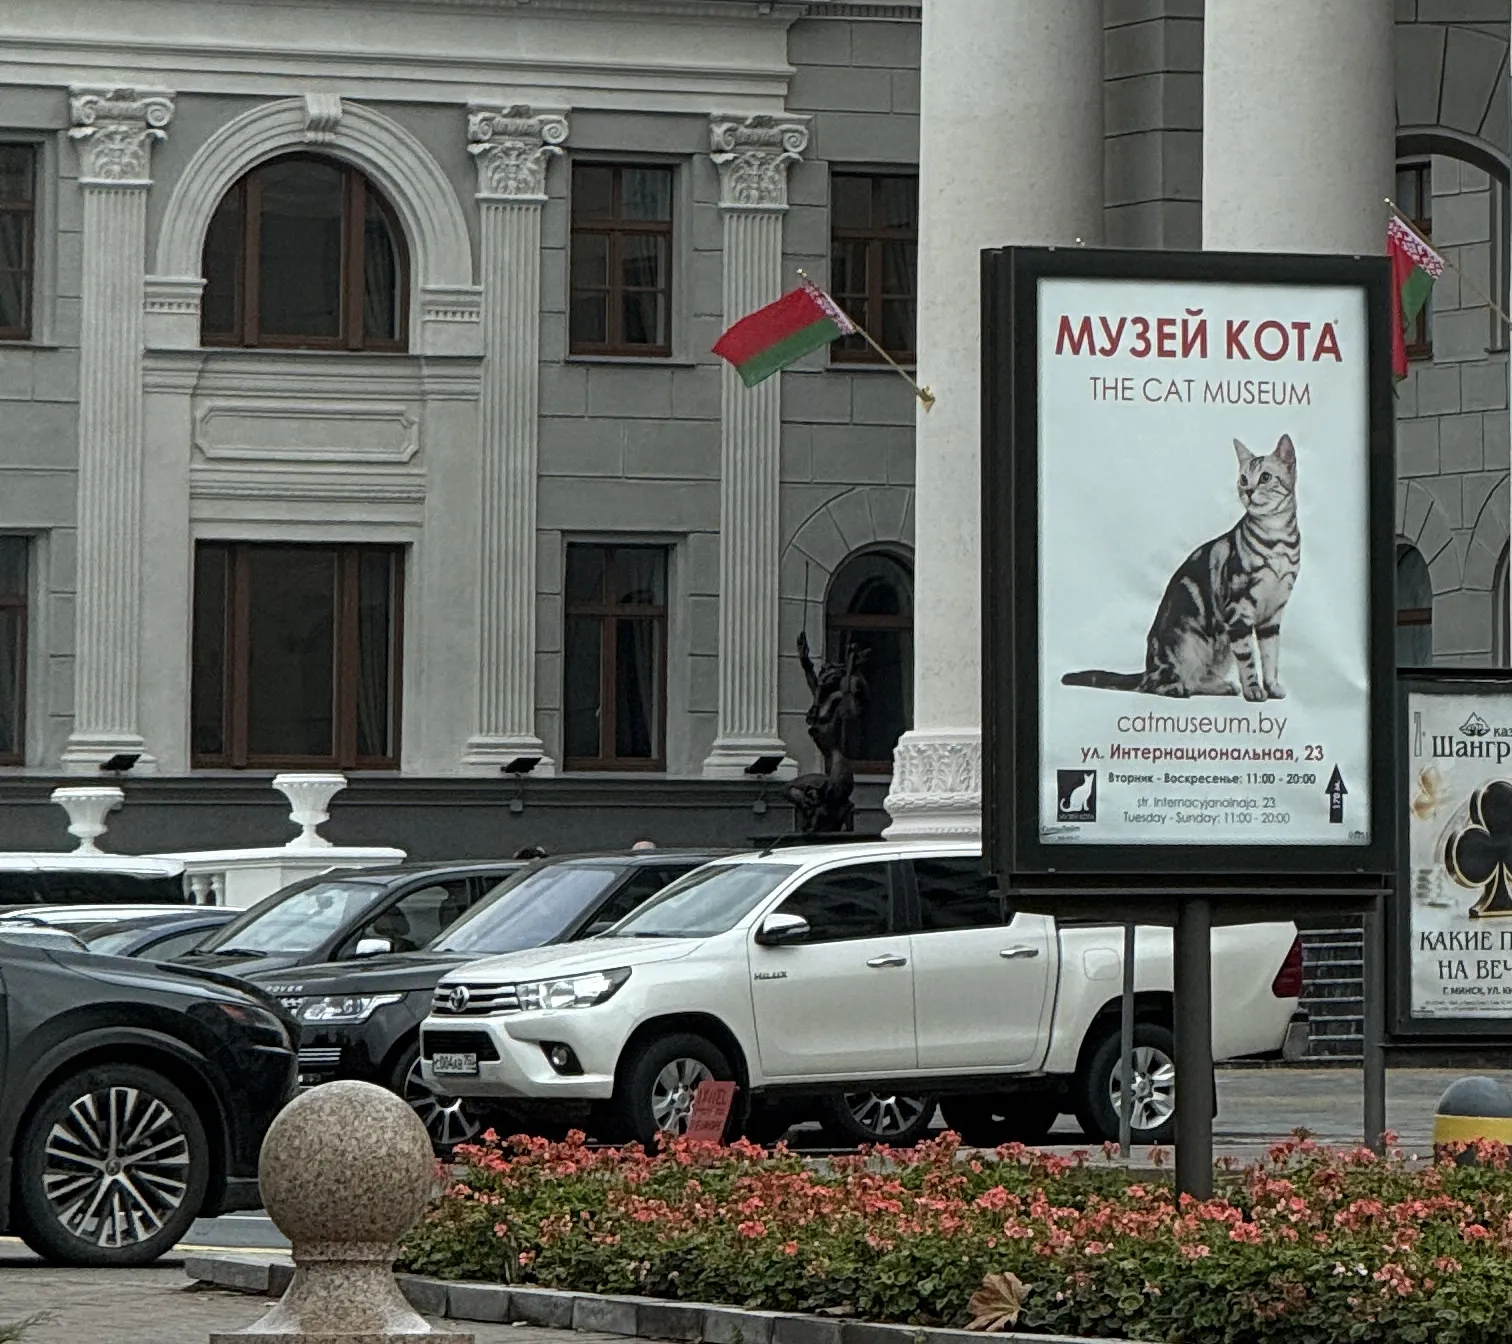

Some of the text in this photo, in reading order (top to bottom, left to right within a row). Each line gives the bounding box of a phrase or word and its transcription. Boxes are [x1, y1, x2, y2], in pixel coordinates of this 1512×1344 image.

[1055, 308, 1343, 363] МУЗЕЙ КОТА
[1089, 376, 1311, 407] THE CAT MUSEUM
[1117, 712, 1287, 739] catmuseum.by
[1081, 743, 1324, 763] ул. Интернациональная, 23
[1108, 772, 1154, 785] Вторник
[1164, 772, 1242, 785] Воскресенье:
[1247, 773, 1275, 784] 11:00
[1286, 773, 1316, 784] 20:00
[1263, 797, 1276, 808] 23
[1123, 812, 1167, 824] Tuesday
[1224, 813, 1252, 823] 11:00
[1262, 813, 1290, 823] 20:00
[1420, 931, 1492, 951] КАКИЕ
[1438, 960, 1469, 980] НА
